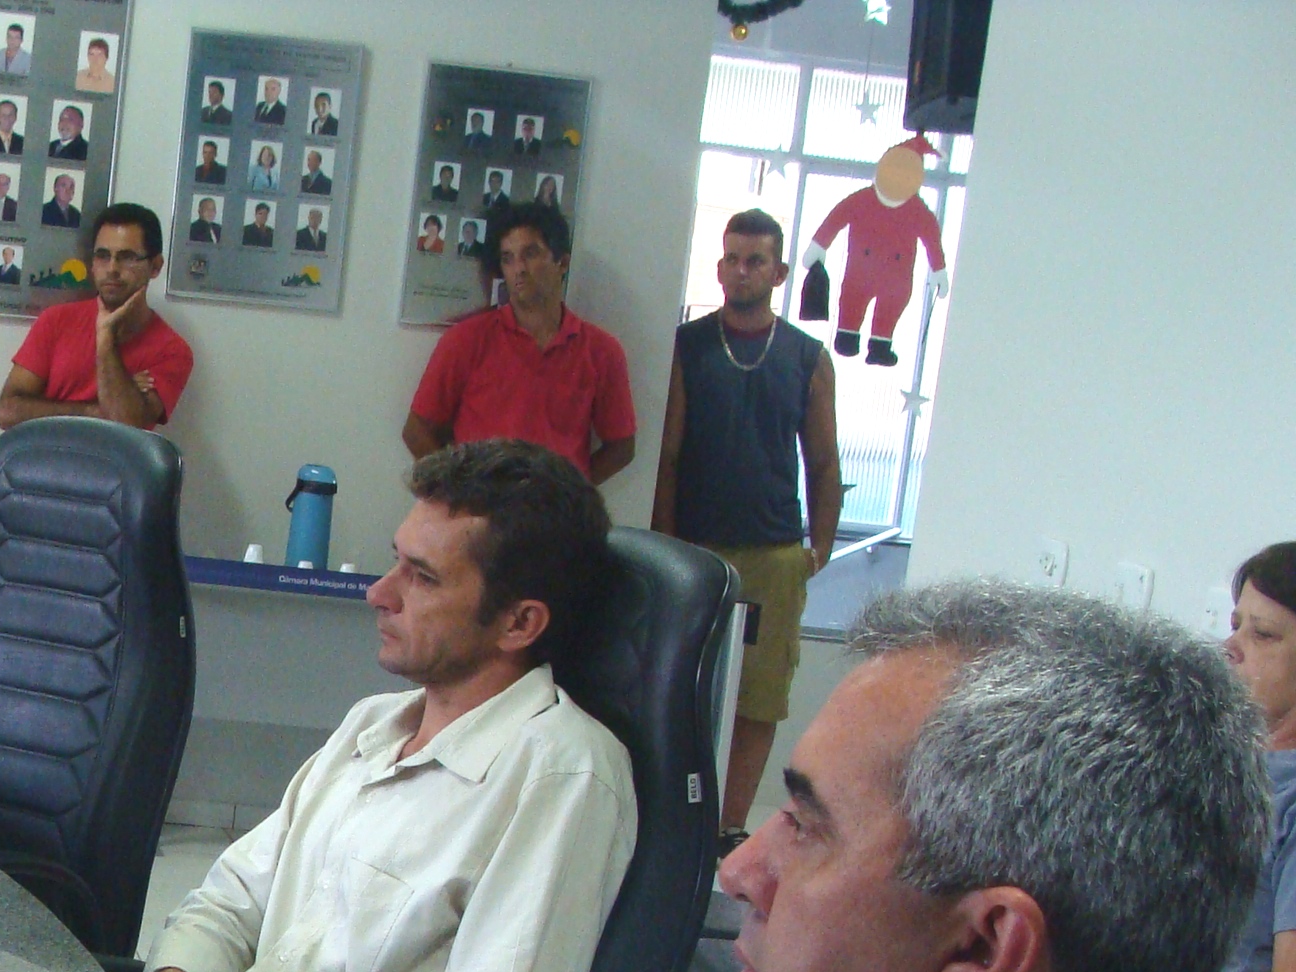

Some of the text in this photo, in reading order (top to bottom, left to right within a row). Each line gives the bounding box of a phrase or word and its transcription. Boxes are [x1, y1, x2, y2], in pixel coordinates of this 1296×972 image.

[278, 575, 308, 585] Câmara
[309, 577, 346, 589] Municipal
[347, 582, 357, 590] de
